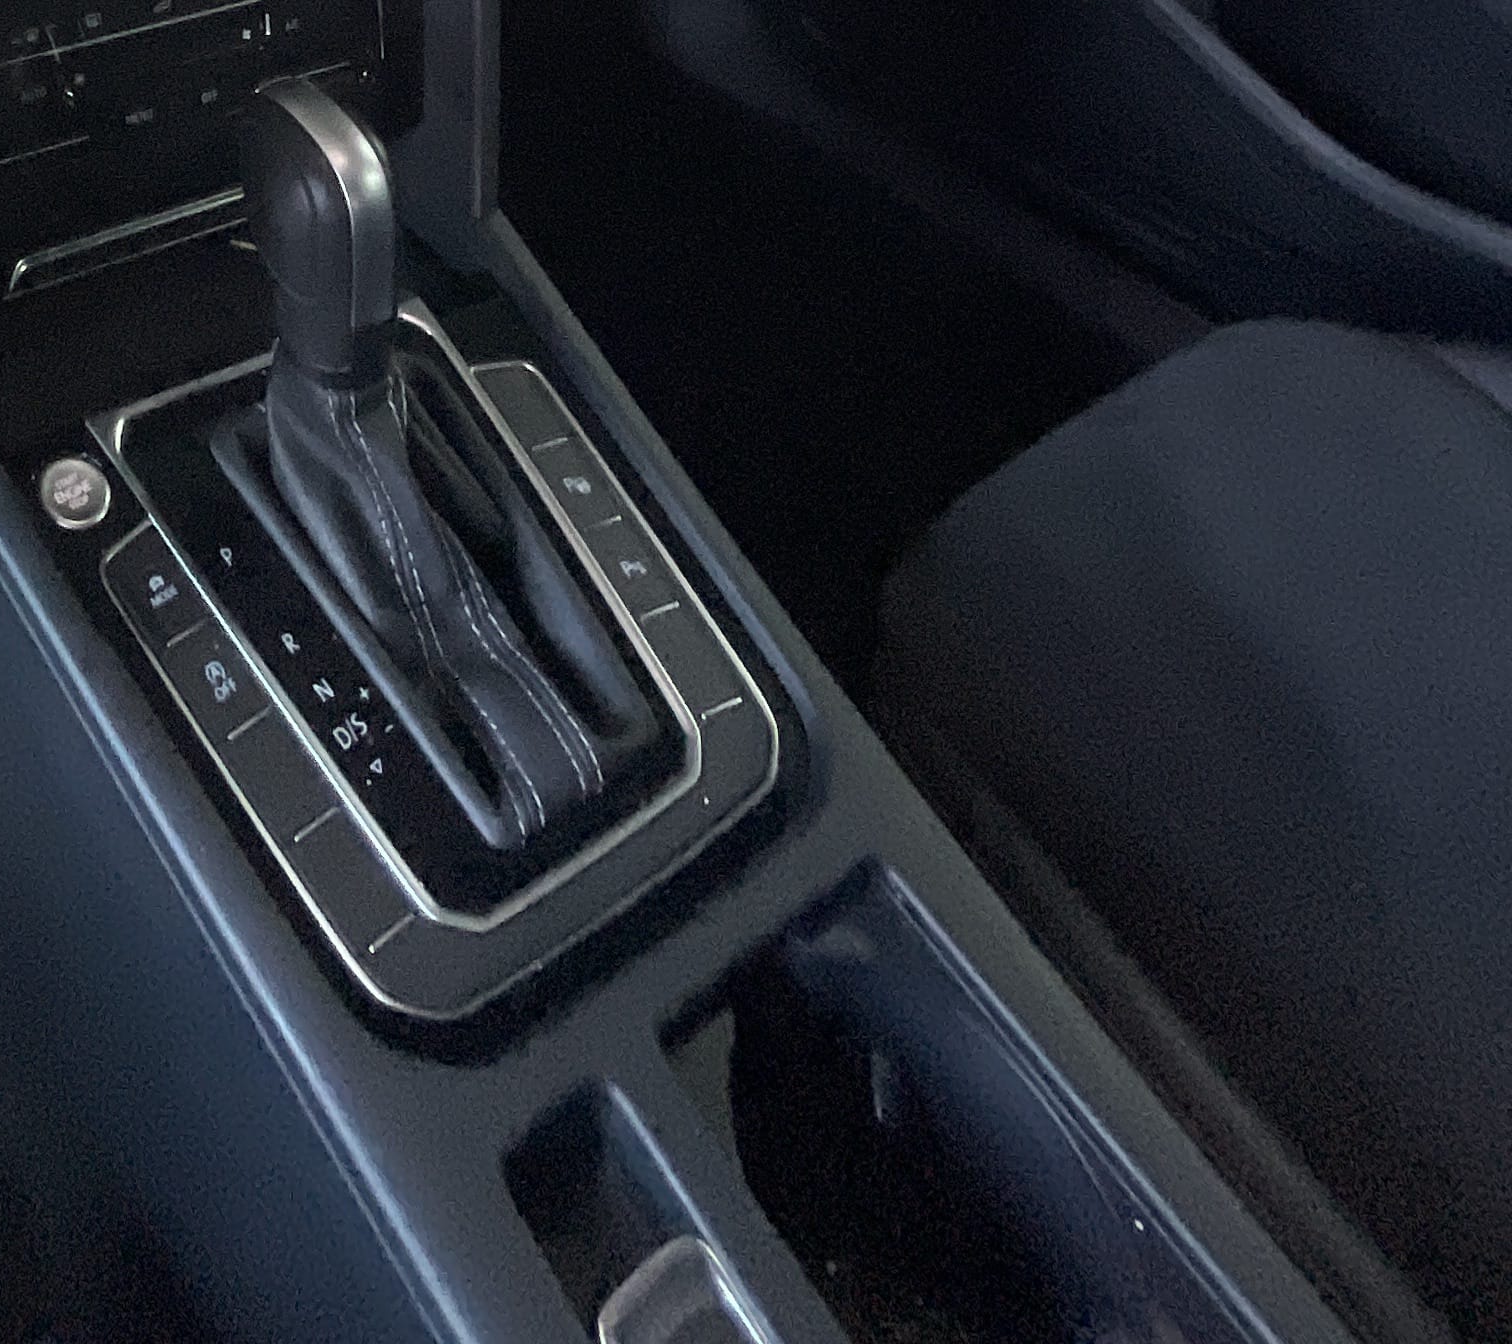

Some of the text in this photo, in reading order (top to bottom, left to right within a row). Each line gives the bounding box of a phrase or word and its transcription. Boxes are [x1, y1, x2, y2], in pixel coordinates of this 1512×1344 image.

[219, 547, 233, 567] P
[281, 632, 300, 655] R
[312, 678, 335, 703] N
[332, 711, 368, 750] D/S
